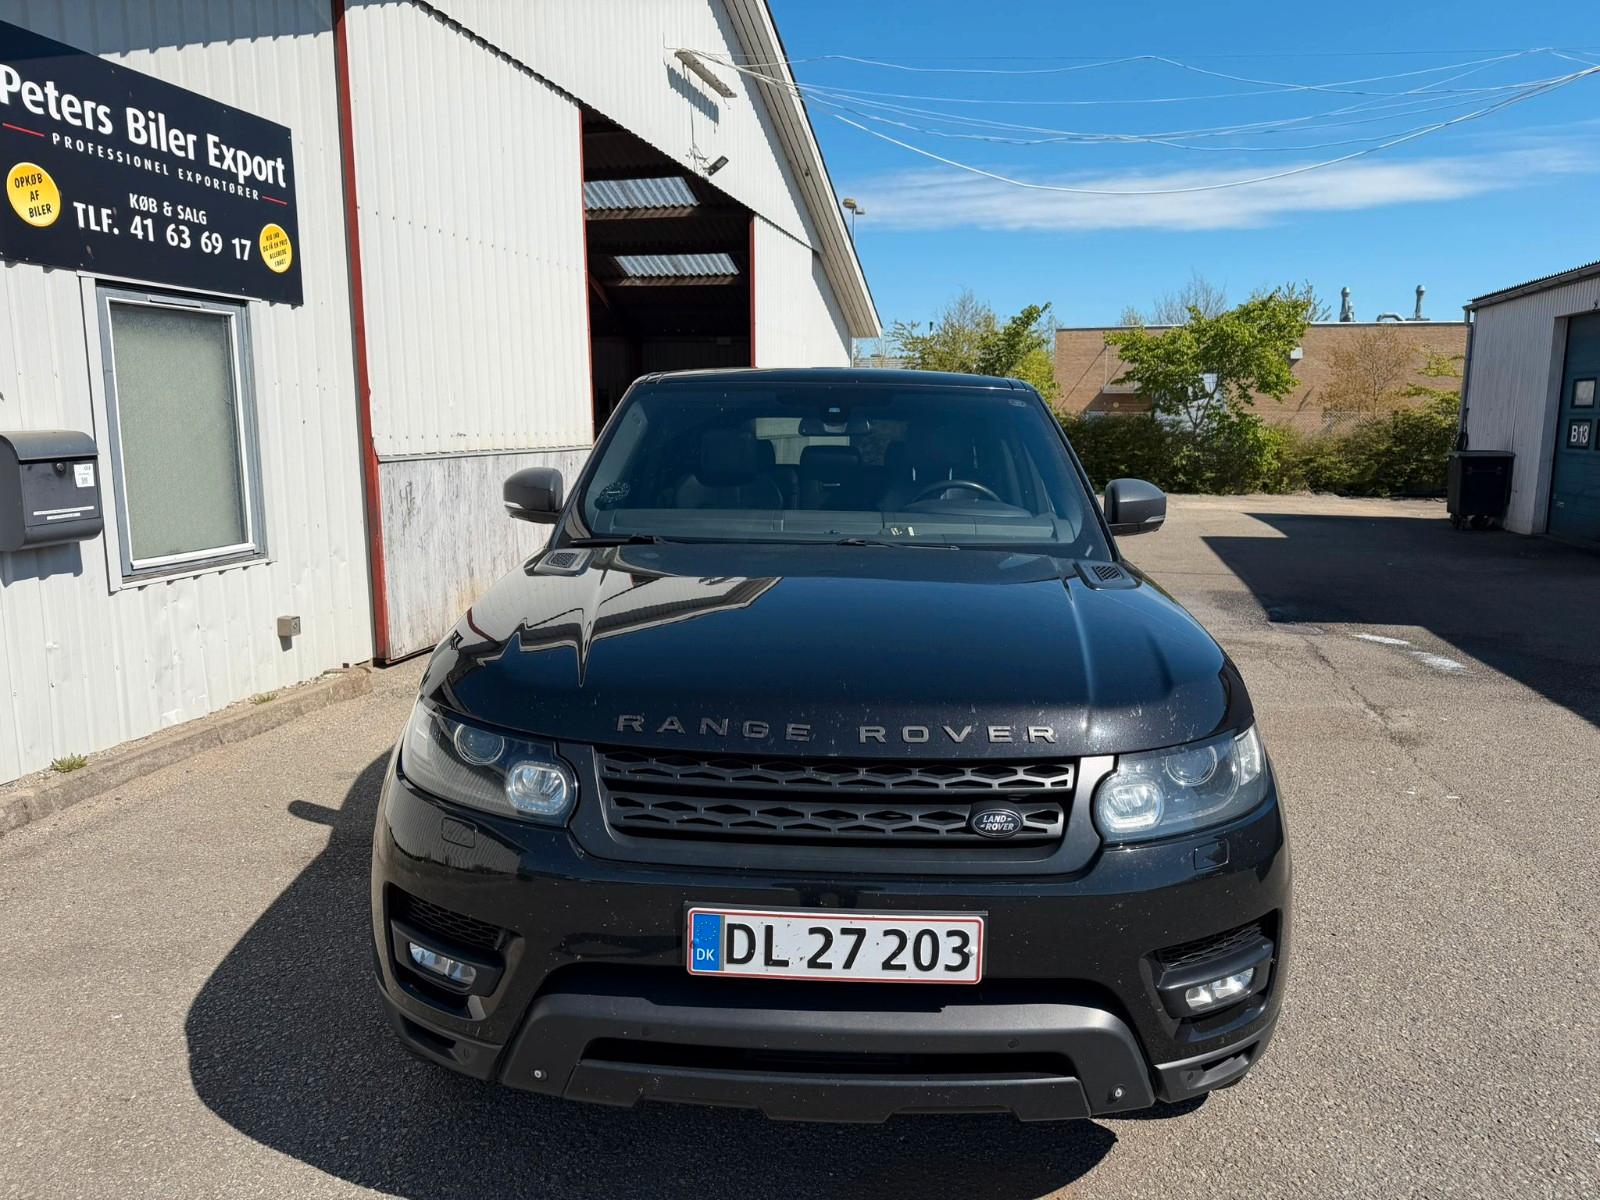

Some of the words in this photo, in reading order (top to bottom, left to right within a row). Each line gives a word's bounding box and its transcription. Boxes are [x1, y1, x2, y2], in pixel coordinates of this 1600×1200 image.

[0, 64, 113, 135] Peters
[126, 107, 197, 160] Biler
[207, 133, 286, 188] Export
[52, 133, 169, 175] PROFESSIONEL
[178, 169, 259, 200] EXPORTØRER
[14, 173, 43, 189] OPKØB
[30, 190, 40, 202] AF
[28, 203, 53, 218] BILER
[129, 193, 158, 213] KØB
[163, 201, 172, 217] &
[177, 204, 207, 225] SALG
[73, 201, 119, 235] TLF.
[130, 215, 155, 242] 41
[166, 223, 191, 249] 63
[201, 231, 223, 255] 69
[232, 238, 251, 260] 17
[1570, 425, 1589, 443] B13
[617, 714, 811, 742] RANGE
[859, 725, 1056, 744] ROVER
[983, 815, 1007, 823] LAND
[985, 823, 1014, 831] ROVER
[696, 948, 715, 961] DK
[726, 922, 790, 968] DL
[807, 927, 867, 971] 27
[881, 929, 971, 972] 203
